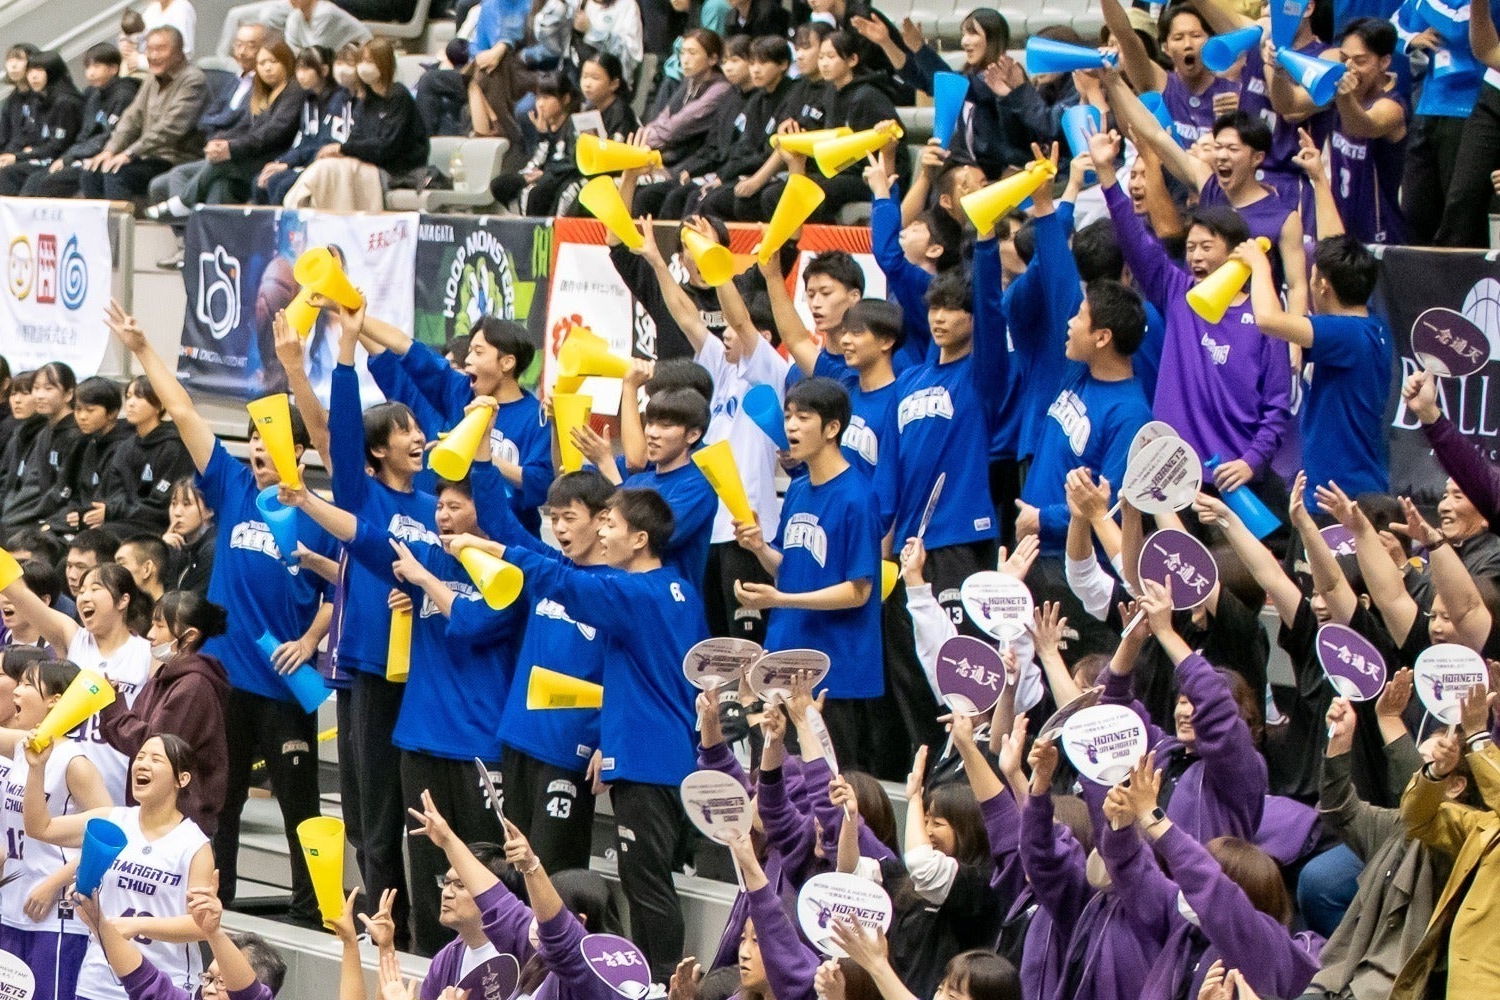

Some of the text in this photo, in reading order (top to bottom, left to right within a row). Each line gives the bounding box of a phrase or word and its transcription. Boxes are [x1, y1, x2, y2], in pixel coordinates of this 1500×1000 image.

[443, 229, 515, 320] HOOP MONSTERS
[1153, 543, 1210, 595] 一念通天
[1322, 639, 1381, 682] 一念通天
[942, 656, 1001, 692] 一念通天
[1442, 673, 1483, 683] HORNETS
[1093, 727, 1139, 746] HORNETS
[546, 796, 572, 818] 43
[112, 859, 182, 887] AMAGATA
[117, 875, 157, 896] CHUO
[832, 903, 885, 921] HORNETS
[590, 950, 643, 968] 一念通天
